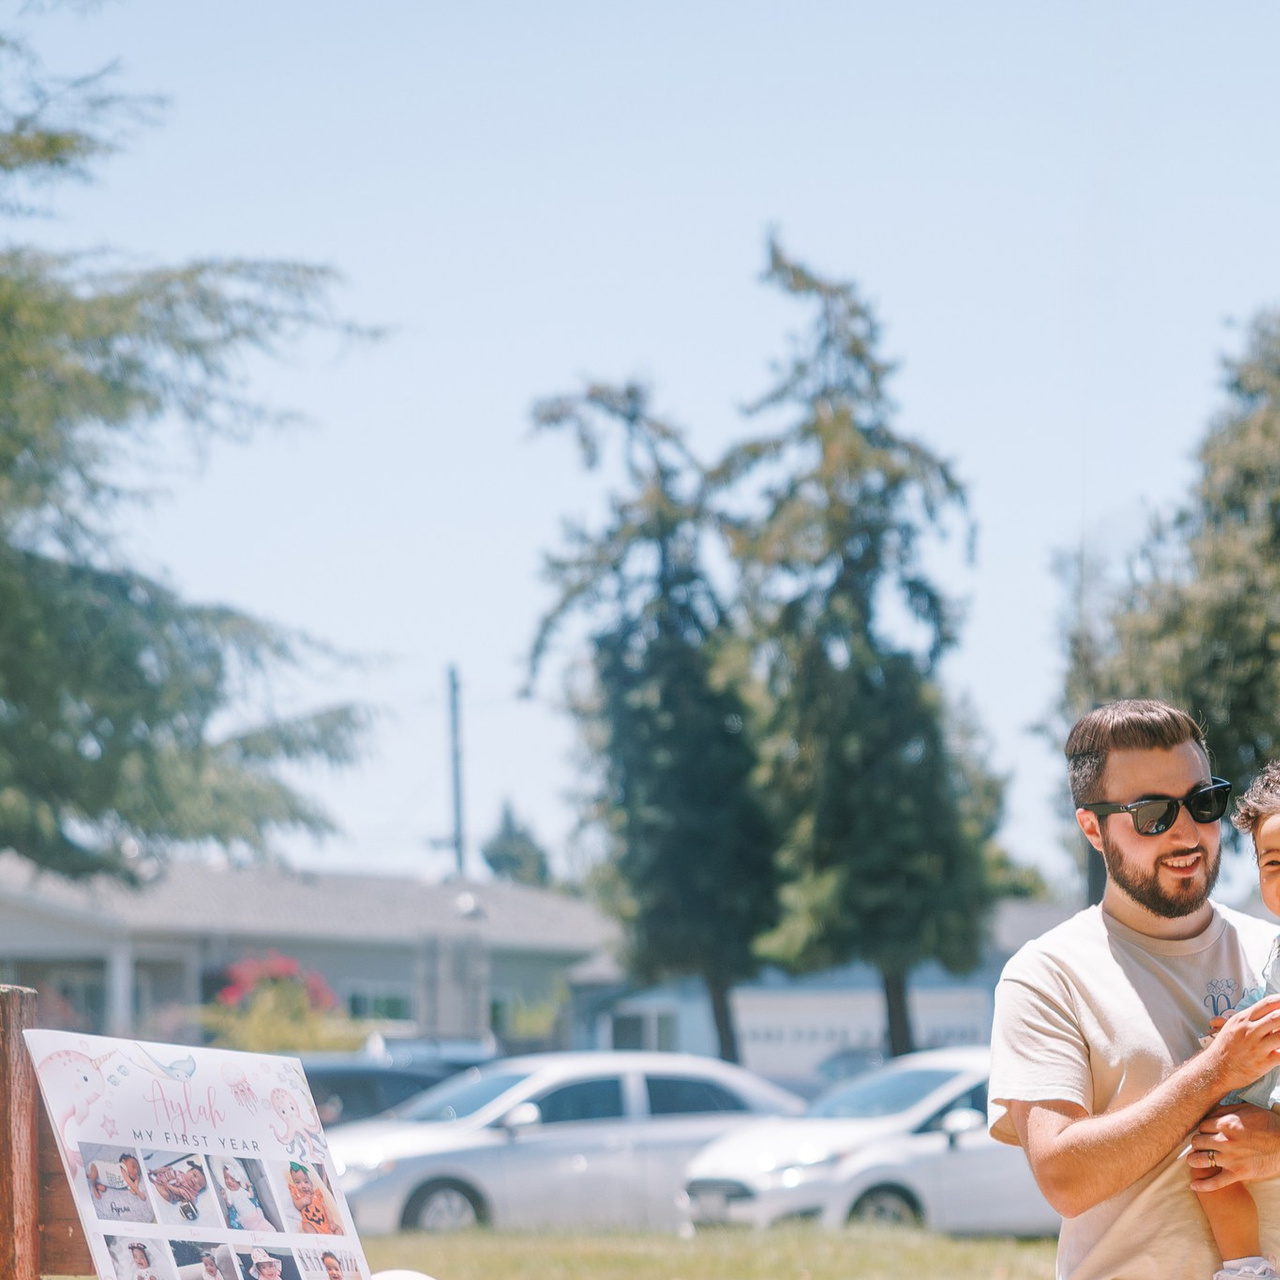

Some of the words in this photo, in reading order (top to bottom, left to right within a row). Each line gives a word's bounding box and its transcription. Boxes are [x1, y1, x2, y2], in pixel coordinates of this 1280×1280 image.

[143, 1079, 226, 1136] Aylah
[132, 1129, 154, 1142] MY
[164, 1132, 209, 1148] FIRST
[217, 1138, 261, 1153] YEAR
